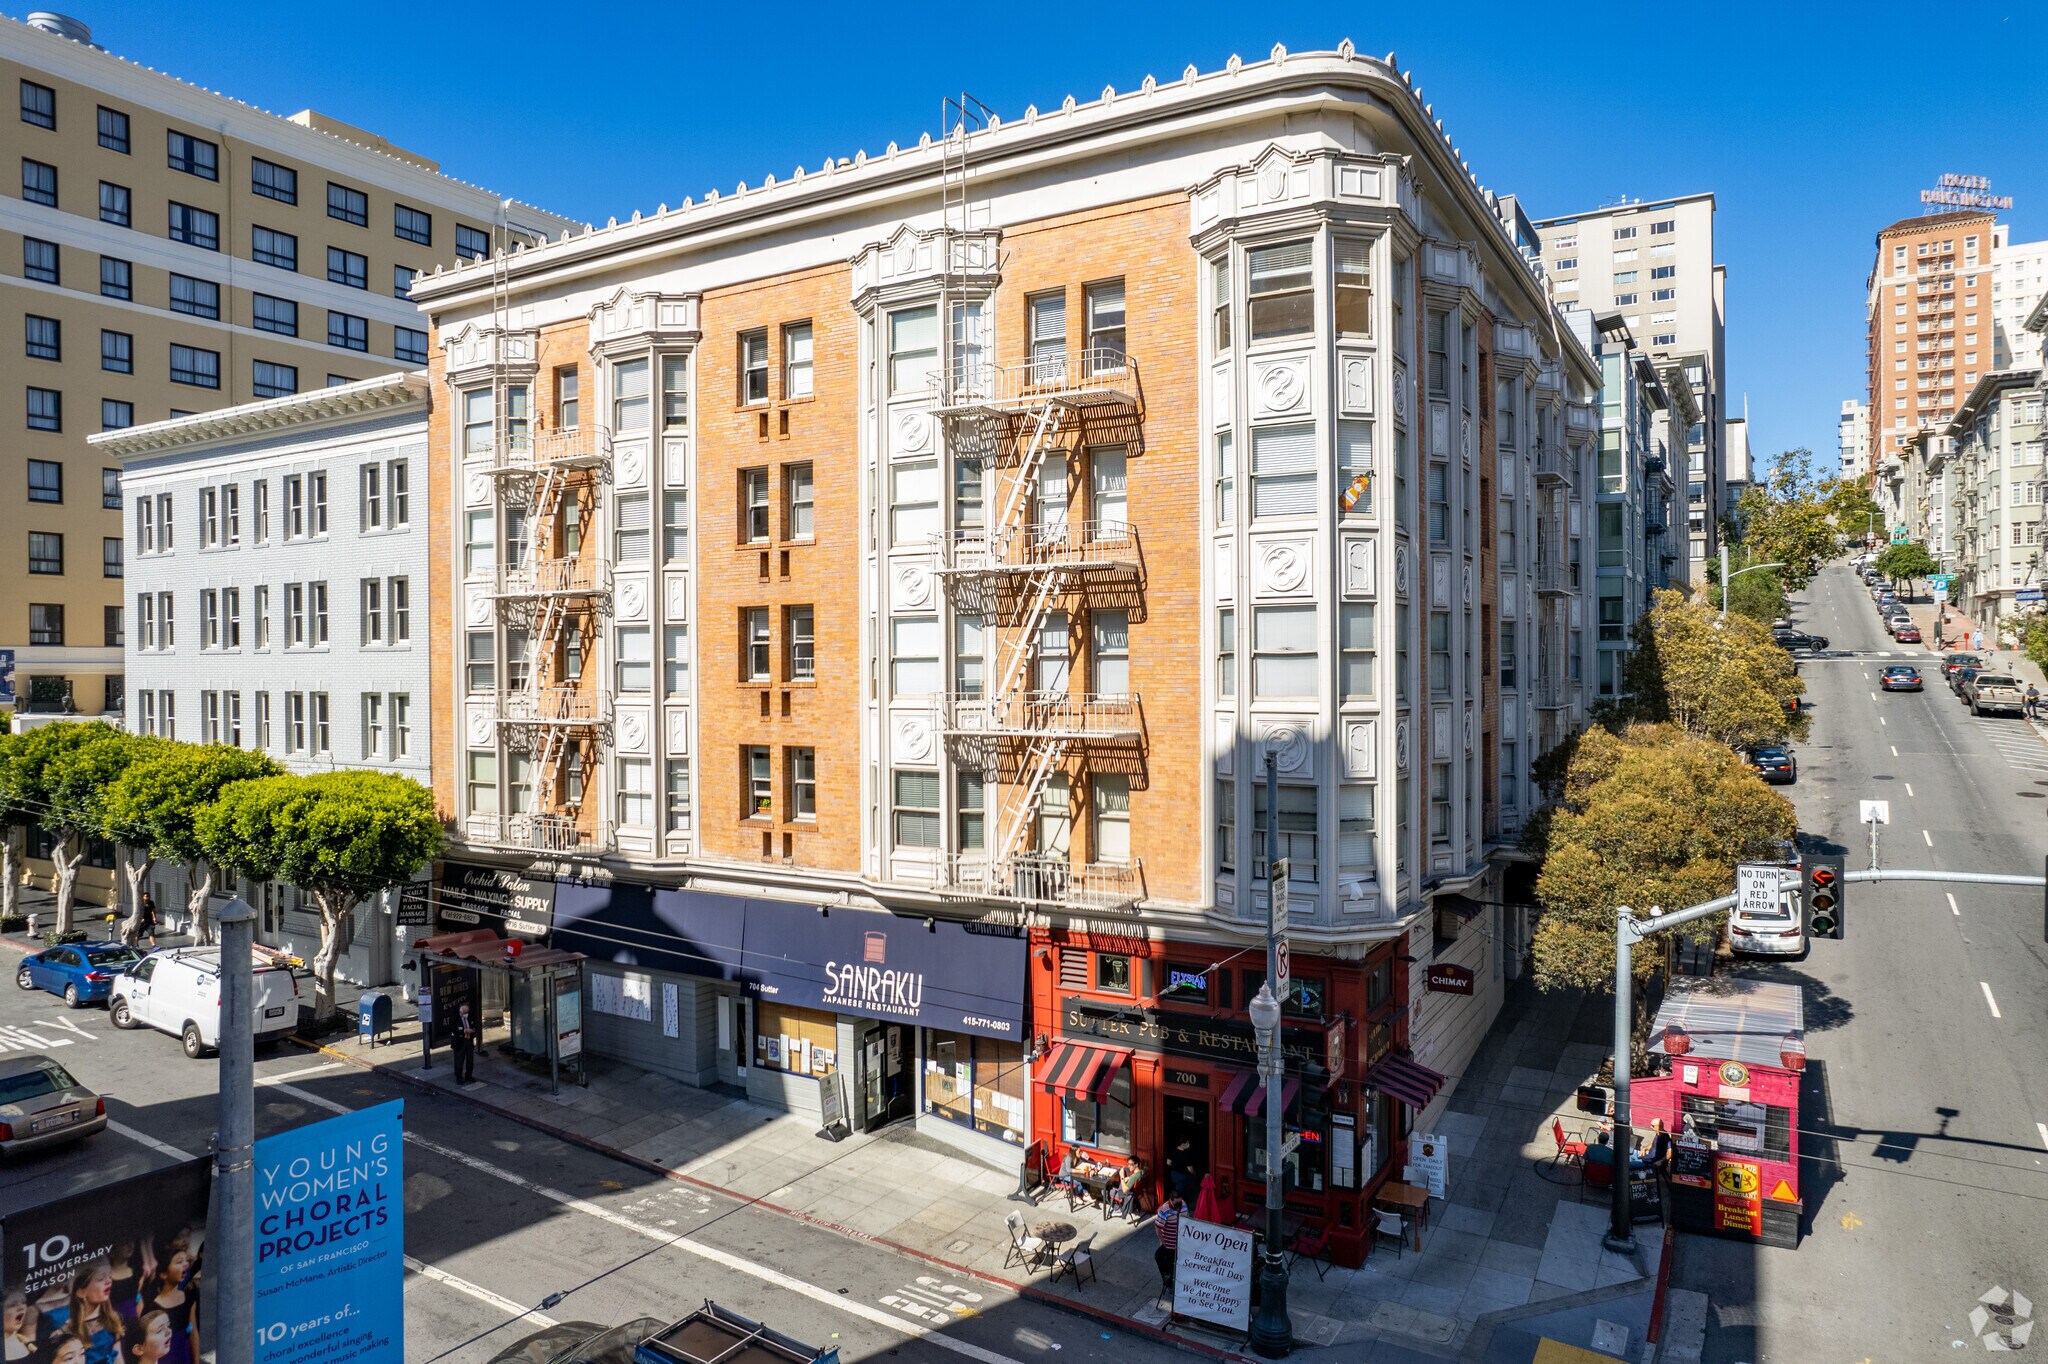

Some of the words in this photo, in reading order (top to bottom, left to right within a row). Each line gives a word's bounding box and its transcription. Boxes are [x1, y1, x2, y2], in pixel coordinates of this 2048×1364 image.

[1944, 174, 1987, 190] HOTEL
[464, 870, 496, 886] Orchid
[498, 874, 530, 892] Salon
[1741, 870, 1752, 878] NO
[1756, 871, 1777, 879] TURN
[442, 886, 467, 900] NAILS
[514, 895, 550, 912] SUPPLY
[1743, 901, 1775, 909] ARROW
[1750, 891, 1768, 899] RED
[500, 908, 521, 919] FACIAL
[760, 983, 779, 995] Sutter
[823, 961, 922, 1008] SANRAKU
[1432, 976, 1468, 987] CHIMAY
[822, 994, 863, 1008] JAPANESE
[866, 1002, 919, 1017] RESTAURANT
[0, 1016, 98, 1052] NLY
[963, 1016, 1010, 1032] 415-771-0803
[1139, 1022, 1169, 1040] PUB
[1178, 1028, 1190, 1043] &
[1198, 1030, 1314, 1060] RESTAUANT
[1176, 1072, 1197, 1084] 700
[263, 1134, 388, 1185] YOUNG
[261, 1157, 388, 1210] WOMEN'S
[260, 1183, 388, 1235] CHORAL
[1718, 1203, 1758, 1217] Breakfast
[1724, 1212, 1750, 1223] Lunch
[259, 1206, 388, 1263] PROJECTS
[1723, 1219, 1752, 1230] Dinner
[1182, 1225, 1211, 1242] Now
[1215, 1233, 1248, 1252] Open
[25, 1244, 113, 1282] ANNIVERSARY
[280, 1264, 294, 1274] OF
[297, 1258, 315, 1270] SAN
[318, 1240, 369, 1262] FRANCISCO
[1194, 1252, 1235, 1268] Breakfast
[25, 1269, 76, 1294] SEASON
[257, 1285, 284, 1298] Susan
[286, 1272, 325, 1290] McMane,
[327, 1262, 356, 1277] Artistic
[358, 1250, 388, 1267] Director
[1183, 1259, 1211, 1272] Served
[1213, 1267, 1224, 1276] All
[1226, 1270, 1244, 1282] Day
[1183, 1284, 1194, 1294] We
[1196, 1290, 1210, 1298] Are
[1213, 1293, 1241, 1307] Happy
[1193, 1278, 1230, 1294] Welcome
[878, 1276, 983, 1325] BUS
[1199, 1300, 1214, 1309] See
[1217, 1305, 1234, 1315] You.
[257, 1322, 287, 1345] 10
[290, 1317, 330, 1338] years
[334, 1304, 360, 1321] of...
[263, 1344, 295, 1362] choral
[298, 1327, 350, 1350] excellence
[289, 1342, 340, 1364] wonderful
[342, 1330, 373, 1350] singing
[359, 1336, 390, 1355] making
